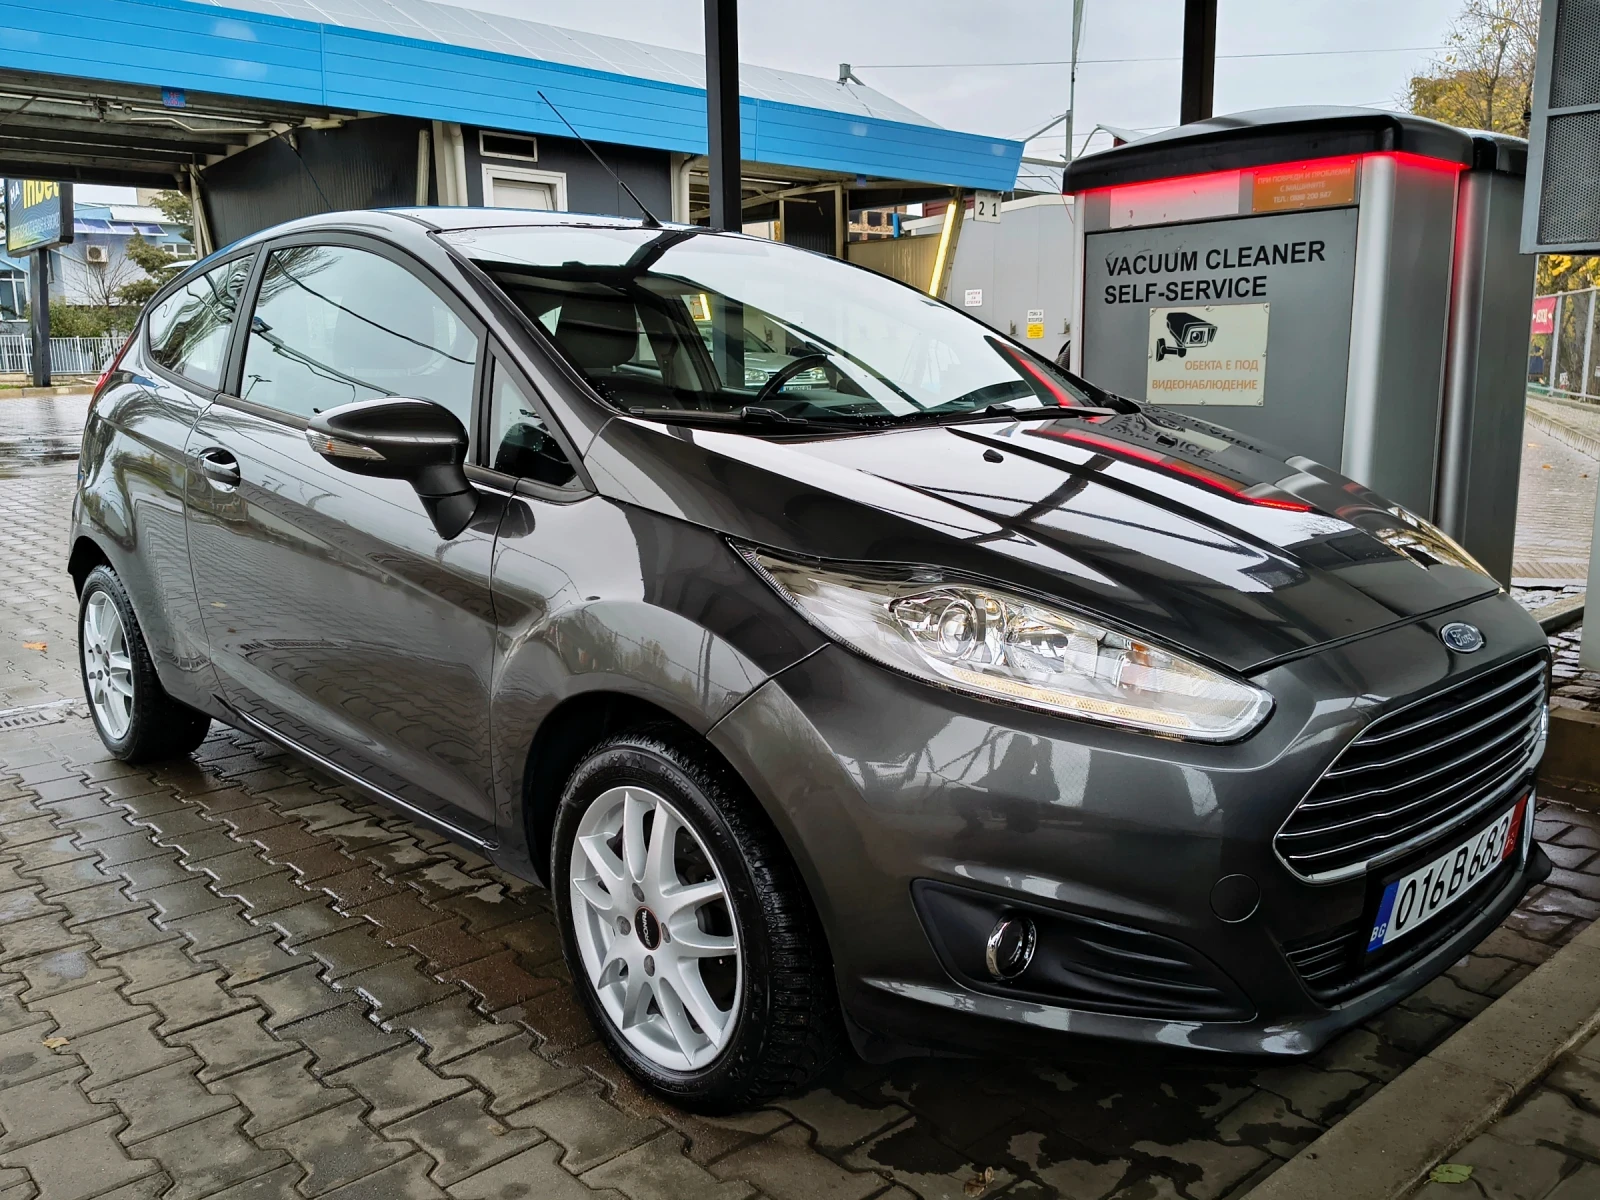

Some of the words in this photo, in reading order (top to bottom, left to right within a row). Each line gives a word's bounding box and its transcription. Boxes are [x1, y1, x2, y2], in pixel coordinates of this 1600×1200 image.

[979, 201, 984, 215] 2
[992, 203, 997, 216] 1
[1105, 251, 1198, 276] VACUUM
[1205, 240, 1326, 270] CLEANER
[1104, 275, 1267, 304] SELF-SERVICE
[1185, 360, 1222, 371] ОБЕКТА
[1226, 360, 1231, 370] Е
[1235, 360, 1259, 372] ПОД
[1152, 380, 1258, 391] ВИДЕОНАБЛЮДЕНИЕ
[1450, 629, 1475, 646] Ford
[1395, 816, 1509, 930] 016B683
[1370, 923, 1387, 942] BG
